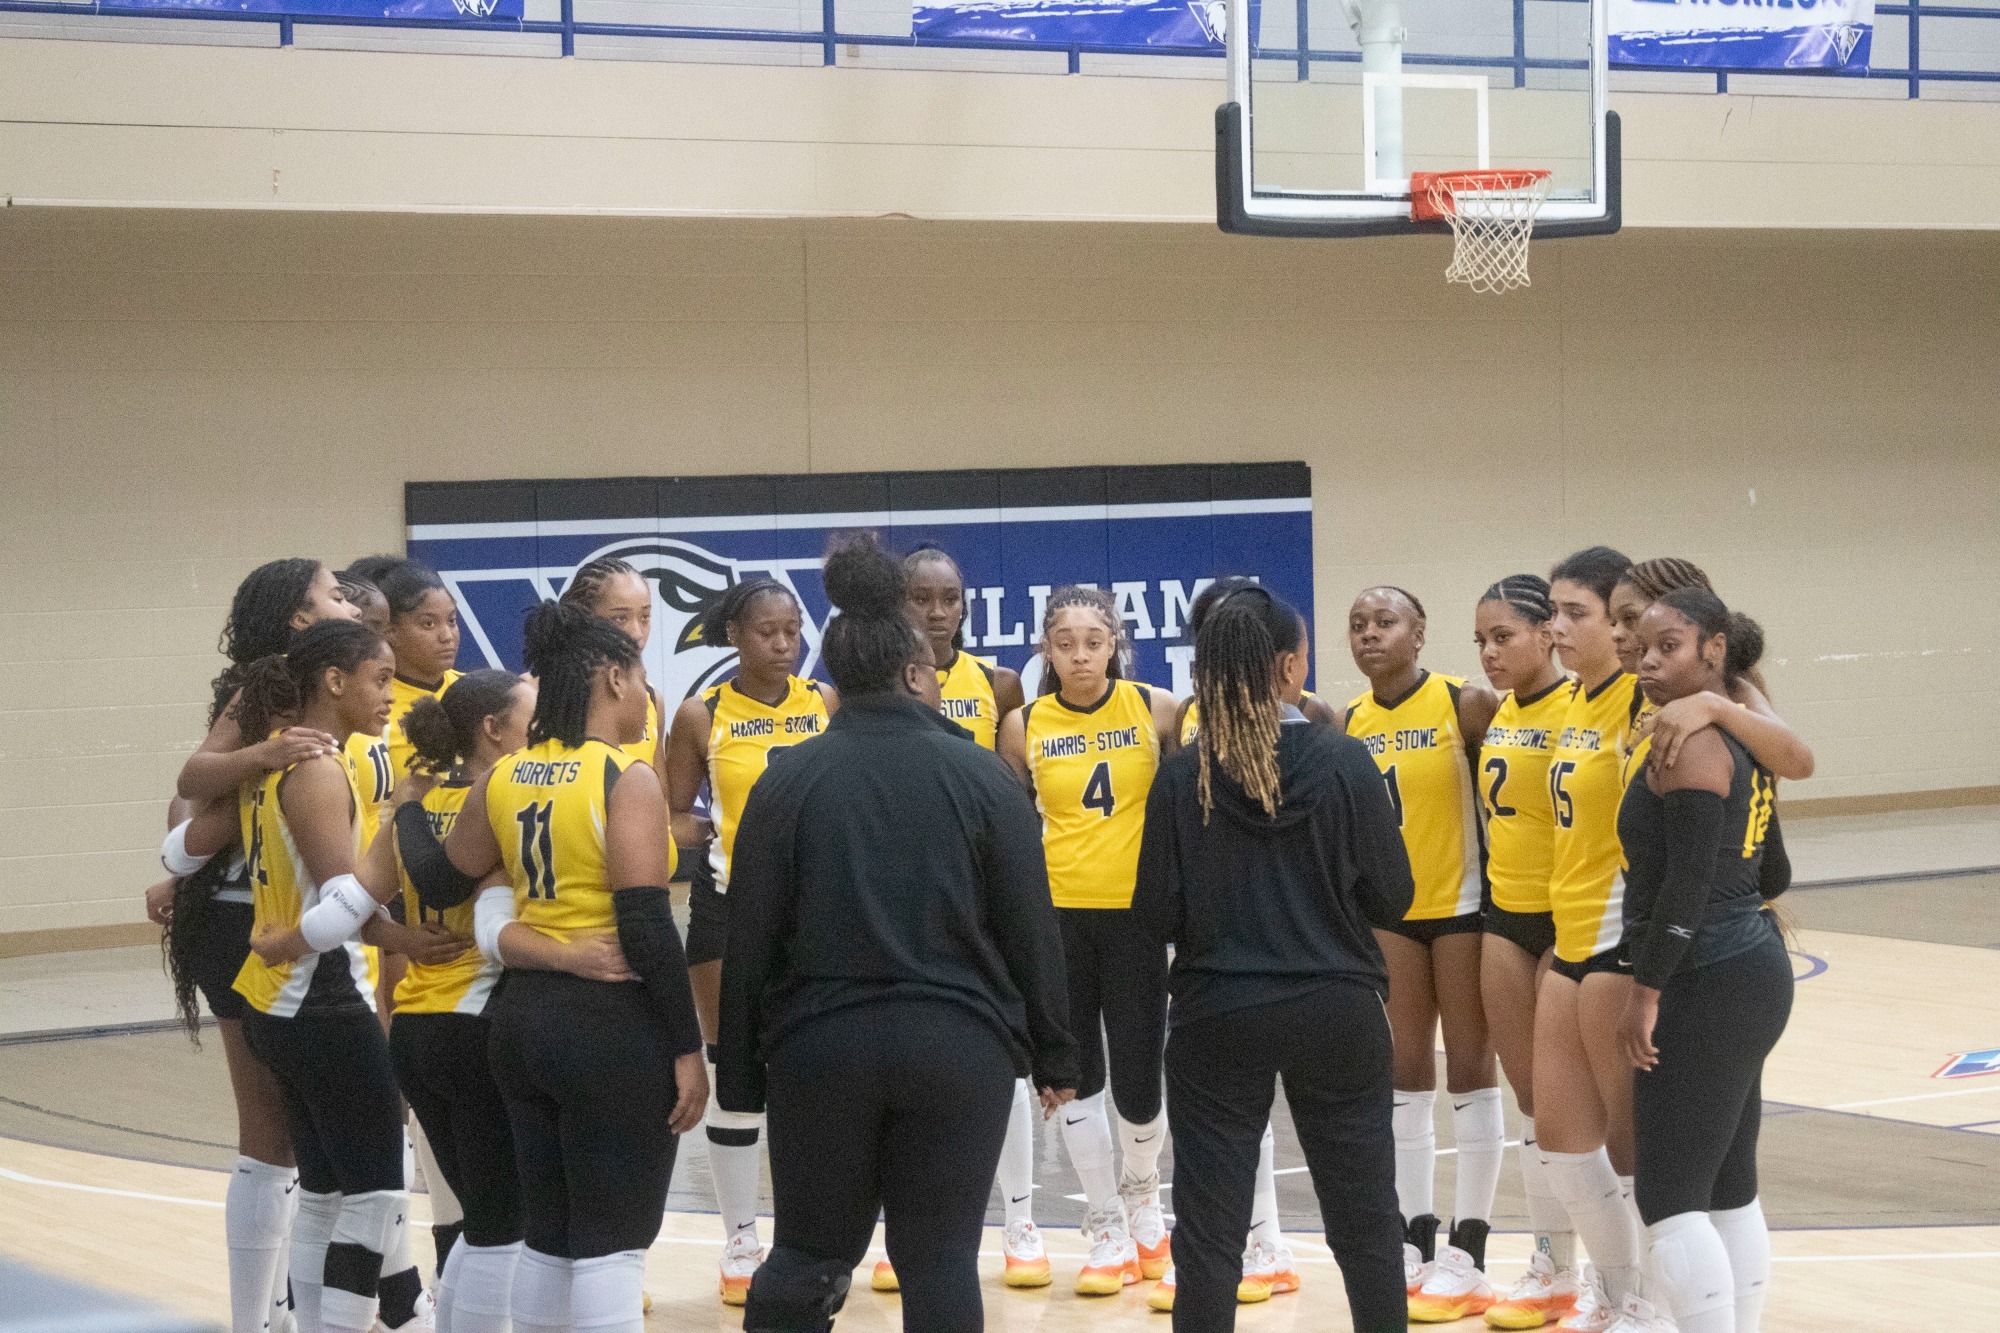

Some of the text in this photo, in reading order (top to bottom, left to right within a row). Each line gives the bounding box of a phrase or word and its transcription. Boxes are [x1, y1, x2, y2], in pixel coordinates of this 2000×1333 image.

[1081, 761, 1115, 817] 4
[1484, 757, 1517, 817] 2
[1550, 761, 1577, 828] 15
[516, 799, 556, 900] 11
